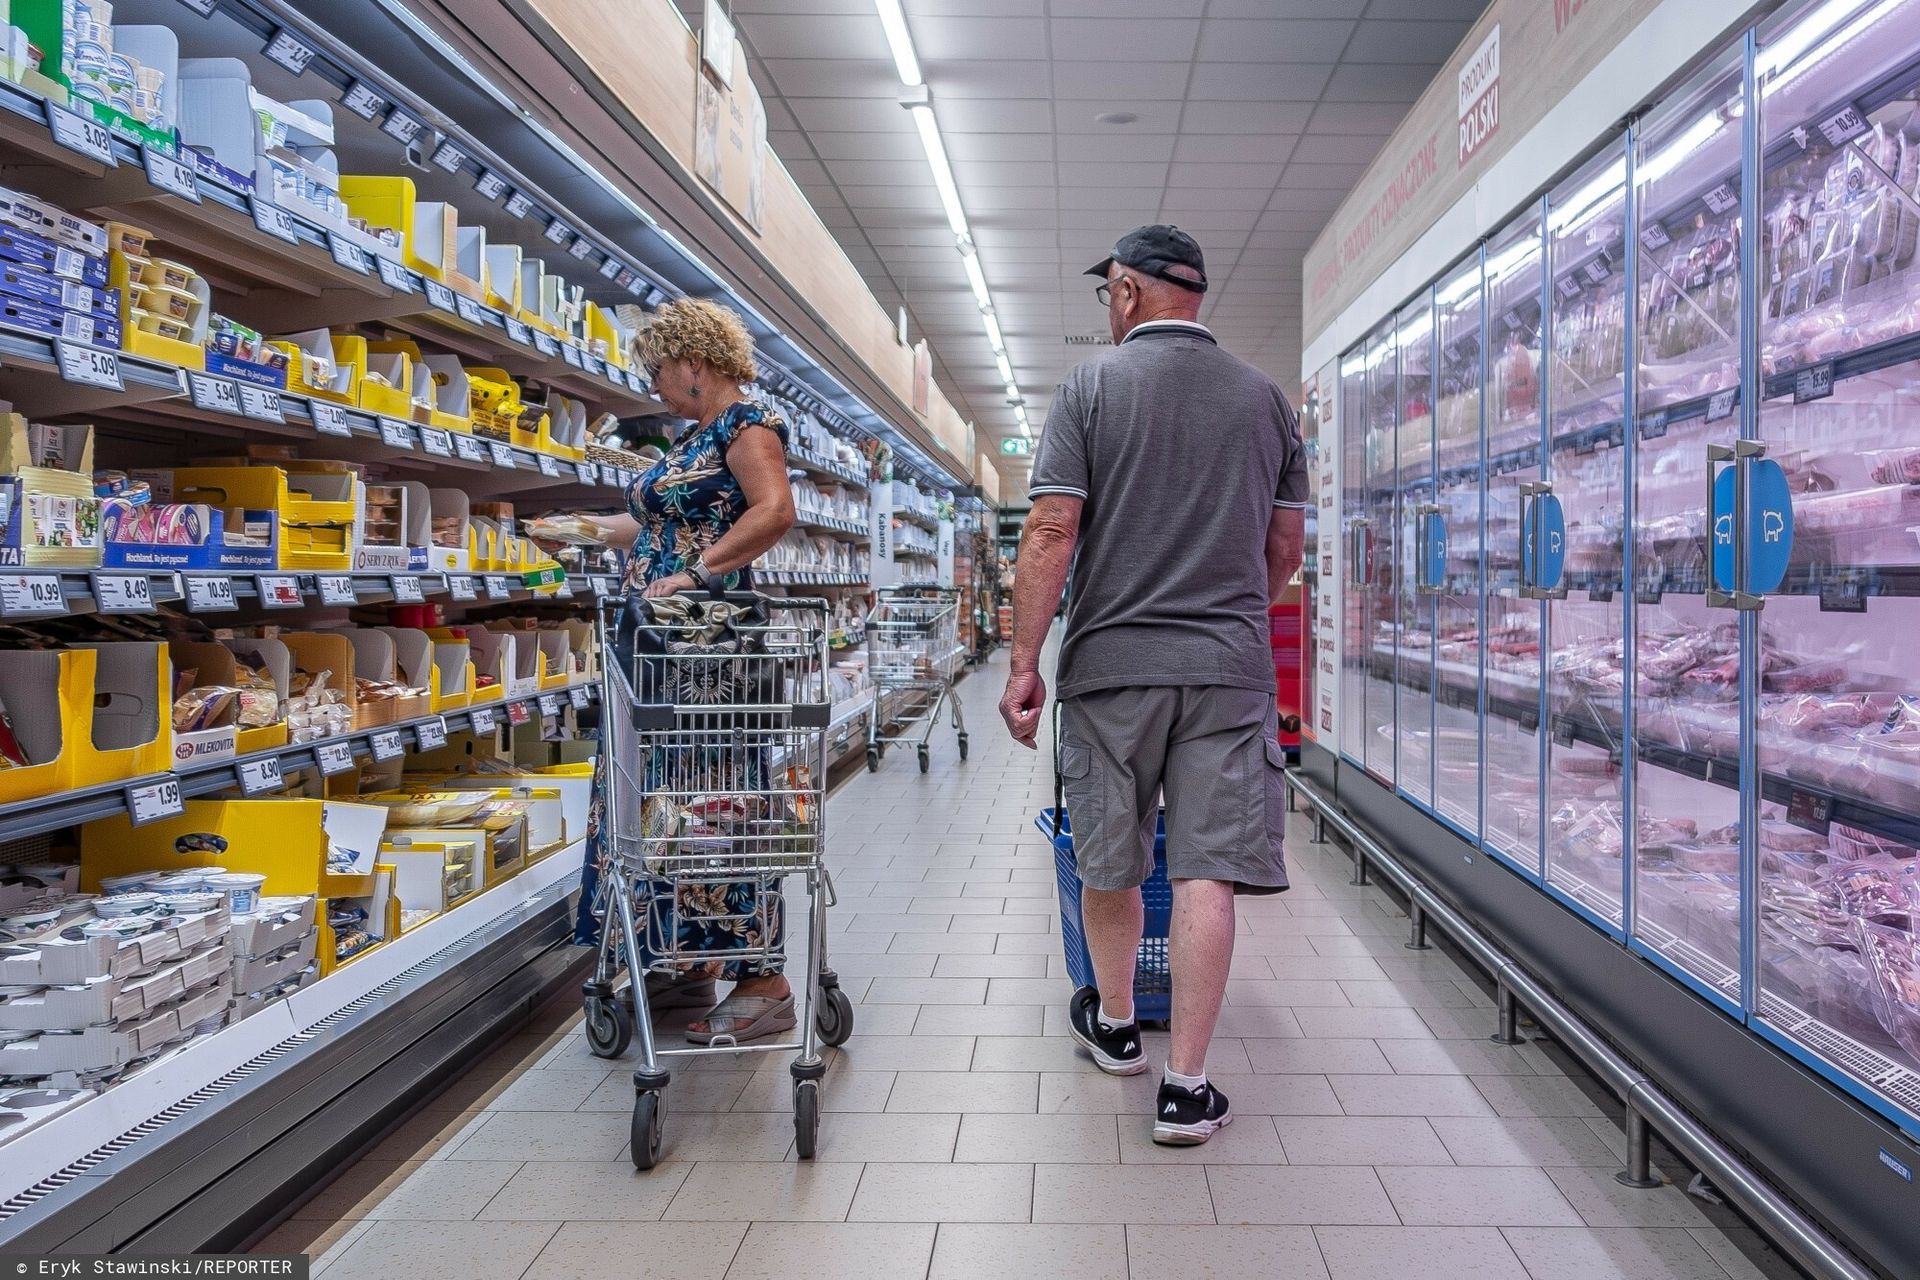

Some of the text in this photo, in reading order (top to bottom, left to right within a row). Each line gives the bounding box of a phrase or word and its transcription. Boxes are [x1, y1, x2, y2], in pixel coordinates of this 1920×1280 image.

[289, 47, 314, 67] 3.74
[1458, 40, 1498, 105] PRODUKT
[1459, 87, 1498, 162] POLSKI
[1834, 111, 1859, 132] 10.99
[83, 123, 109, 151] 3.03
[174, 171, 193, 188] 4.19
[91, 353, 116, 377] 5.09
[1812, 371, 1829, 388] 15.99
[215, 383, 235, 403] 5.94
[261, 393, 278, 411] 3.35
[330, 409, 345, 425] 2.09
[877, 512, 890, 560] Kabanosy
[366, 554, 381, 567] SERY
[30, 583, 59, 601] 10.99
[124, 579, 147, 599] 8.49
[207, 582, 230, 599] 10.99
[336, 579, 351, 595] 8.49
[194, 737, 235, 755] MLEKOVITA
[334, 746, 350, 762] 12.99
[260, 759, 279, 780] 8.90
[158, 783, 179, 805] 1.99
